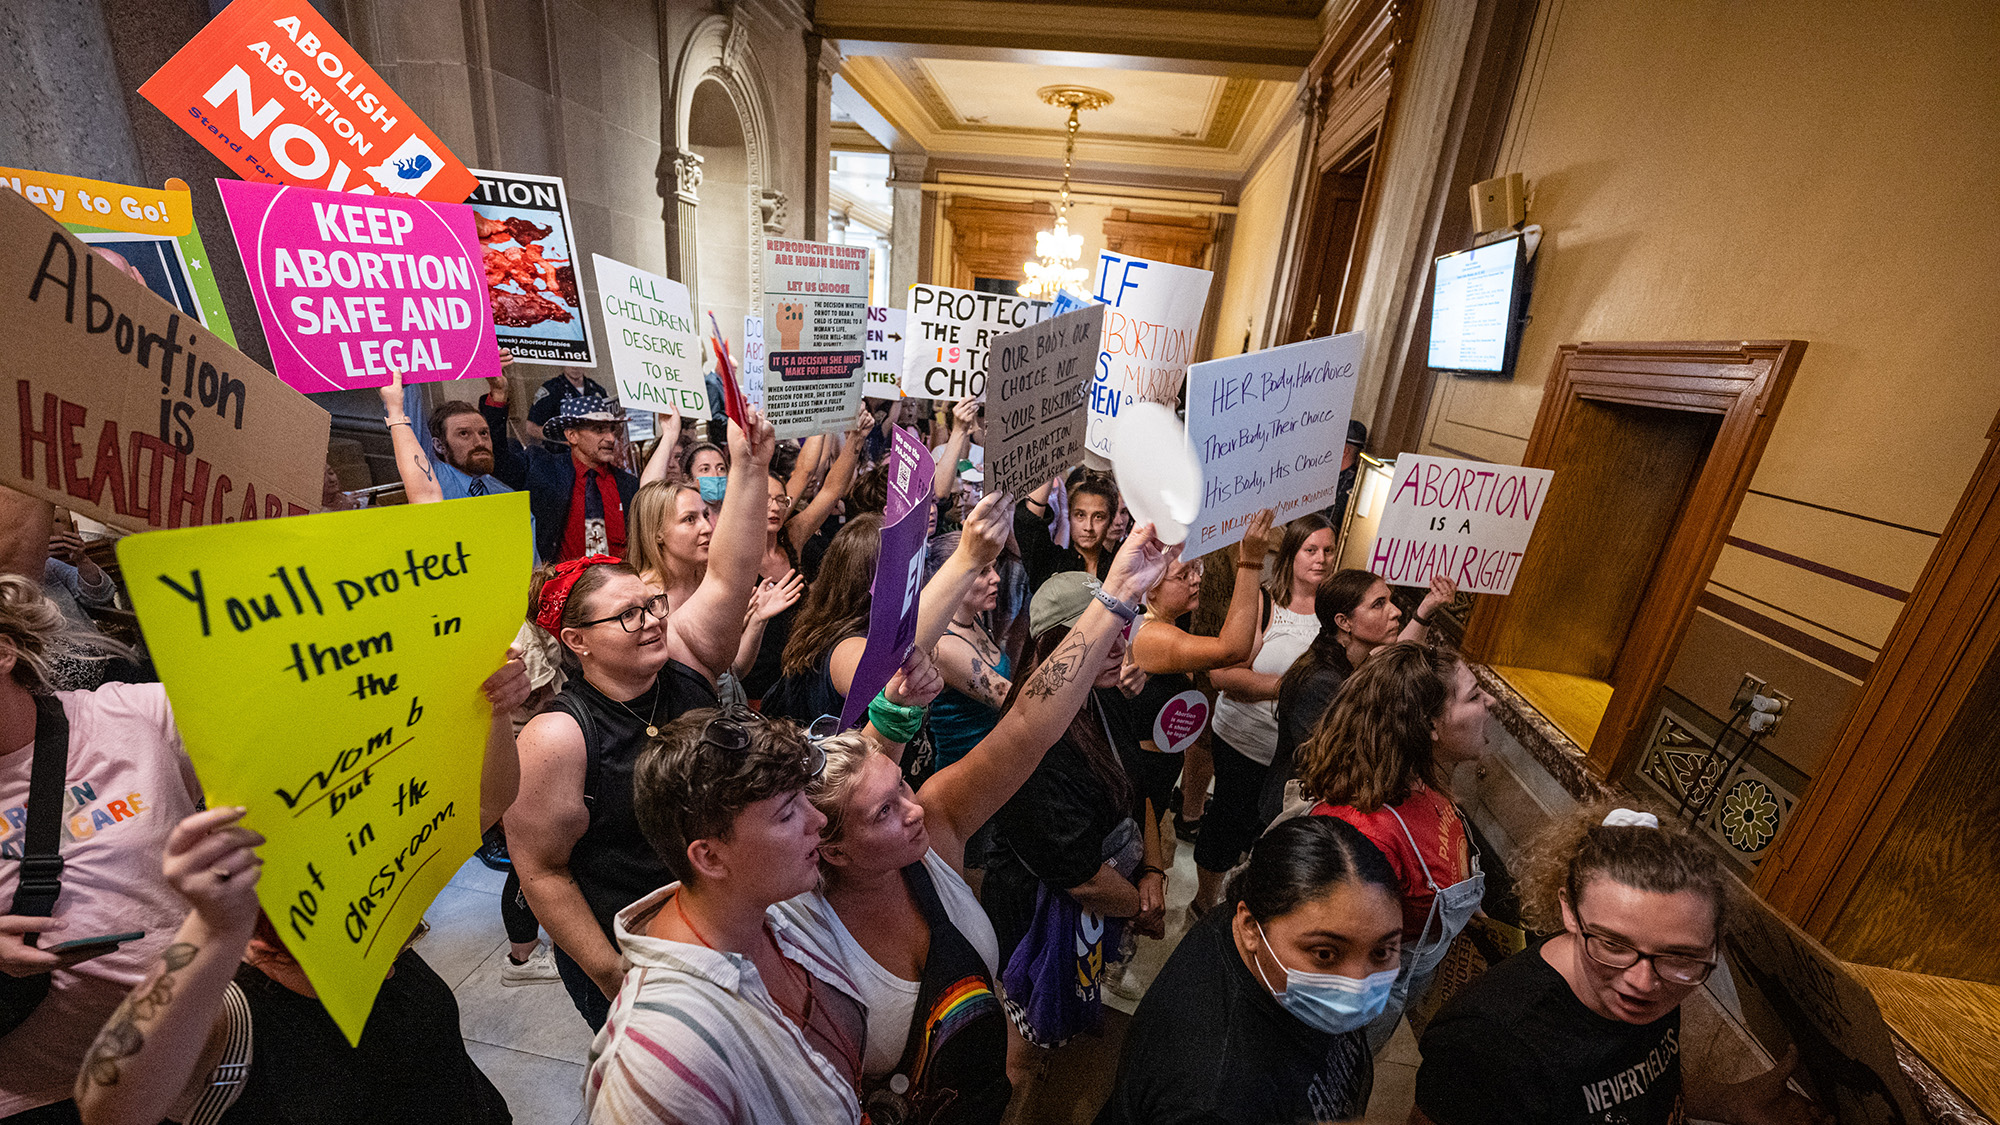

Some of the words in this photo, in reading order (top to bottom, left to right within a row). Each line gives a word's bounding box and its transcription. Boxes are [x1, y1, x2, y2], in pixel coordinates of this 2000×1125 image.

[273, 16, 398, 133] ABOLISH
[247, 41, 373, 156] ABORTION
[188, 107, 242, 153] Stand
[245, 155, 274, 180] For
[78, 190, 111, 214] to
[120, 197, 169, 223] Go!
[312, 202, 413, 246] KEEP
[767, 240, 834, 256] REPRODUCTIVE
[836, 246, 866, 259] RIGHTS
[775, 254, 793, 265] ARE
[795, 256, 828, 268] HUMAN
[829, 259, 860, 270] RIGHTS
[275, 248, 471, 290] ABORTION
[787, 281, 802, 291] LET
[805, 282, 817, 292] US
[818, 283, 850, 294] CHOOSE
[1093, 254, 1149, 308] IF
[630, 275, 664, 303] ALL
[914, 287, 1052, 328] PROTECT
[29, 231, 246, 429] Abortion
[291, 296, 392, 335] SAFE
[401, 297, 472, 331] AND
[606, 295, 690, 333] CHILDREN
[920, 322, 961, 344] THE
[498, 344, 588, 360] dequal.net
[519, 338, 546, 347] Aborted
[548, 340, 570, 348] Babies
[623, 329, 686, 358] DESERVE
[1002, 345, 1029, 373] OUR
[1036, 328, 1067, 359] BODY.
[1073, 322, 1090, 344] OUR
[1101, 310, 1193, 365] ABORTION
[339, 338, 452, 378] LEGAL
[642, 361, 662, 378] TO
[665, 367, 683, 382] BE
[772, 357, 780, 366] IT
[782, 356, 789, 366] IS
[790, 356, 796, 366] A
[797, 355, 828, 365] DECISION
[829, 355, 842, 365] SHE
[843, 355, 862, 364] MUST
[785, 366, 805, 376] MAKE
[806, 366, 819, 376] FOR
[820, 365, 850, 375] HERSELF.
[623, 380, 704, 410] WANTED
[767, 394, 792, 402] DECISION
[784, 384, 818, 392] GOVERNMENT
[819, 382, 843, 390] CONTROLS
[1001, 367, 1050, 401] CHOICE.
[1057, 357, 1078, 379] NOT
[1122, 364, 1183, 398] MURDER
[1211, 372, 1258, 417] HER
[1296, 361, 1314, 388] Her
[767, 402, 790, 410] TREATED
[805, 406, 835, 414] RESPONSIBLE
[1002, 404, 1035, 434] YOUR
[1090, 382, 1122, 418] HEN
[160, 387, 195, 455] is
[1204, 434, 1237, 464] Their
[1239, 423, 1270, 452] Body,
[1269, 416, 1299, 440] Their
[1300, 409, 1335, 427] Choice
[17, 380, 310, 529] HEALTHCA
[895, 432, 903, 444] We
[903, 441, 912, 452] are
[912, 447, 920, 461] the
[992, 446, 1023, 482] KEEP
[1026, 424, 1072, 461] ABORTION
[1024, 454, 1049, 480] LEGAL
[1051, 446, 1065, 463] FOR
[1068, 440, 1081, 455] ALL.
[1010, 472, 1045, 501] UESTIONS
[1205, 476, 1232, 509] His
[1234, 471, 1266, 495] Body,
[1270, 460, 1290, 485] His
[1294, 450, 1333, 472] Choice
[1393, 462, 1543, 521] ABORTION
[1201, 525, 1217, 544] BE
[1221, 509, 1261, 536] INCLUSIV
[1281, 498, 1299, 516] YOUR
[1429, 517, 1446, 531] IS
[1458, 519, 1471, 534] A
[333, 541, 471, 612] protect
[1371, 537, 1458, 583] HUMAN
[1456, 546, 1523, 591] RIGHT
[283, 632, 393, 682] them
[431, 614, 461, 637] in
[349, 674, 399, 700] the
[1175, 710, 1196, 718] Abortion
[1174, 731, 1187, 739] legal
[329, 768, 374, 818] but
[289, 862, 325, 941] not
[346, 823, 375, 857] in
[392, 776, 429, 817] the
